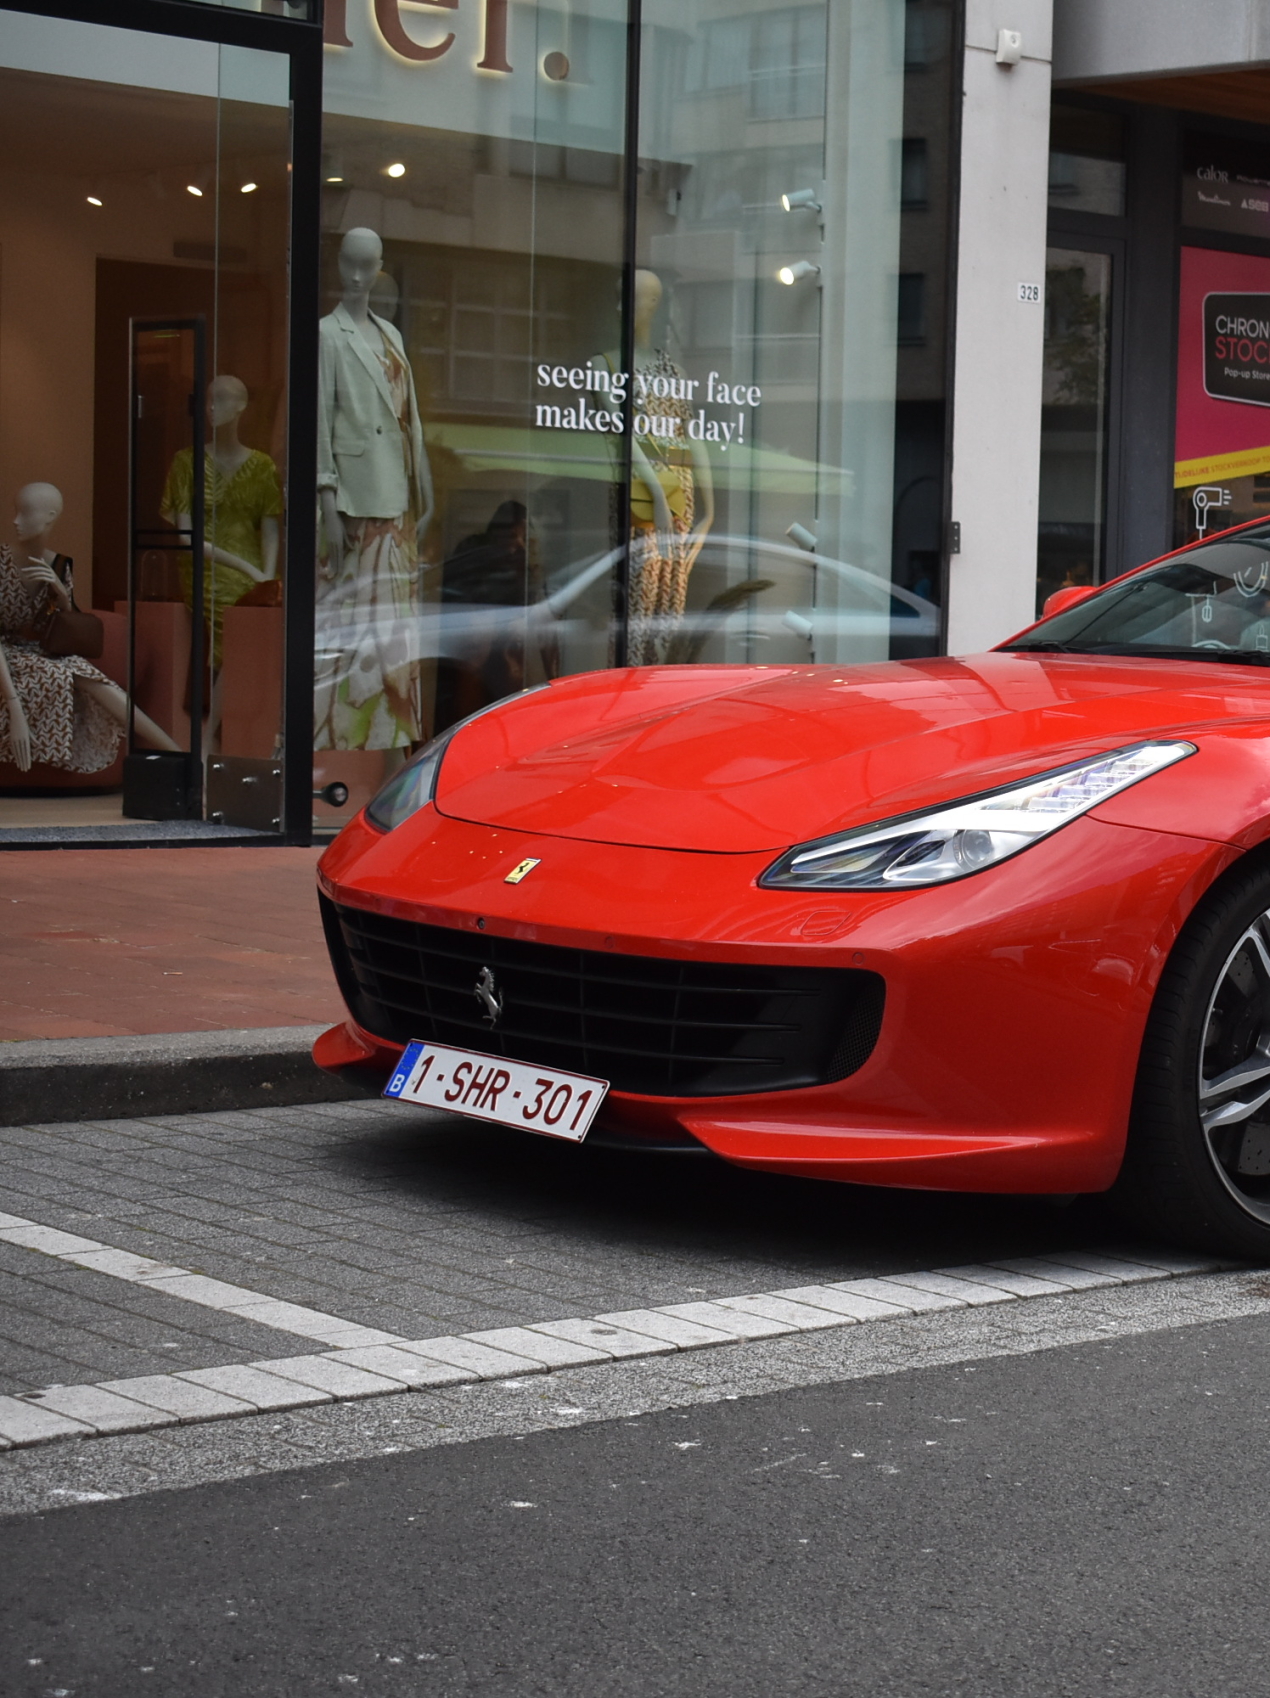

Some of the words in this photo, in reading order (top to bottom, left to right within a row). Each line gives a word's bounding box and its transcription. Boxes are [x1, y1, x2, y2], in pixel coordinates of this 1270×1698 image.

[1020, 284, 1039, 301] 328
[1224, 366, 1250, 379] Pop-up
[1252, 369, 1270, 381] Store
[537, 361, 629, 404] seeing
[636, 374, 700, 405] your
[706, 371, 762, 407] face
[535, 398, 624, 434] makes
[633, 412, 682, 438] our
[688, 409, 746, 452] day!
[389, 1074, 405, 1093] B
